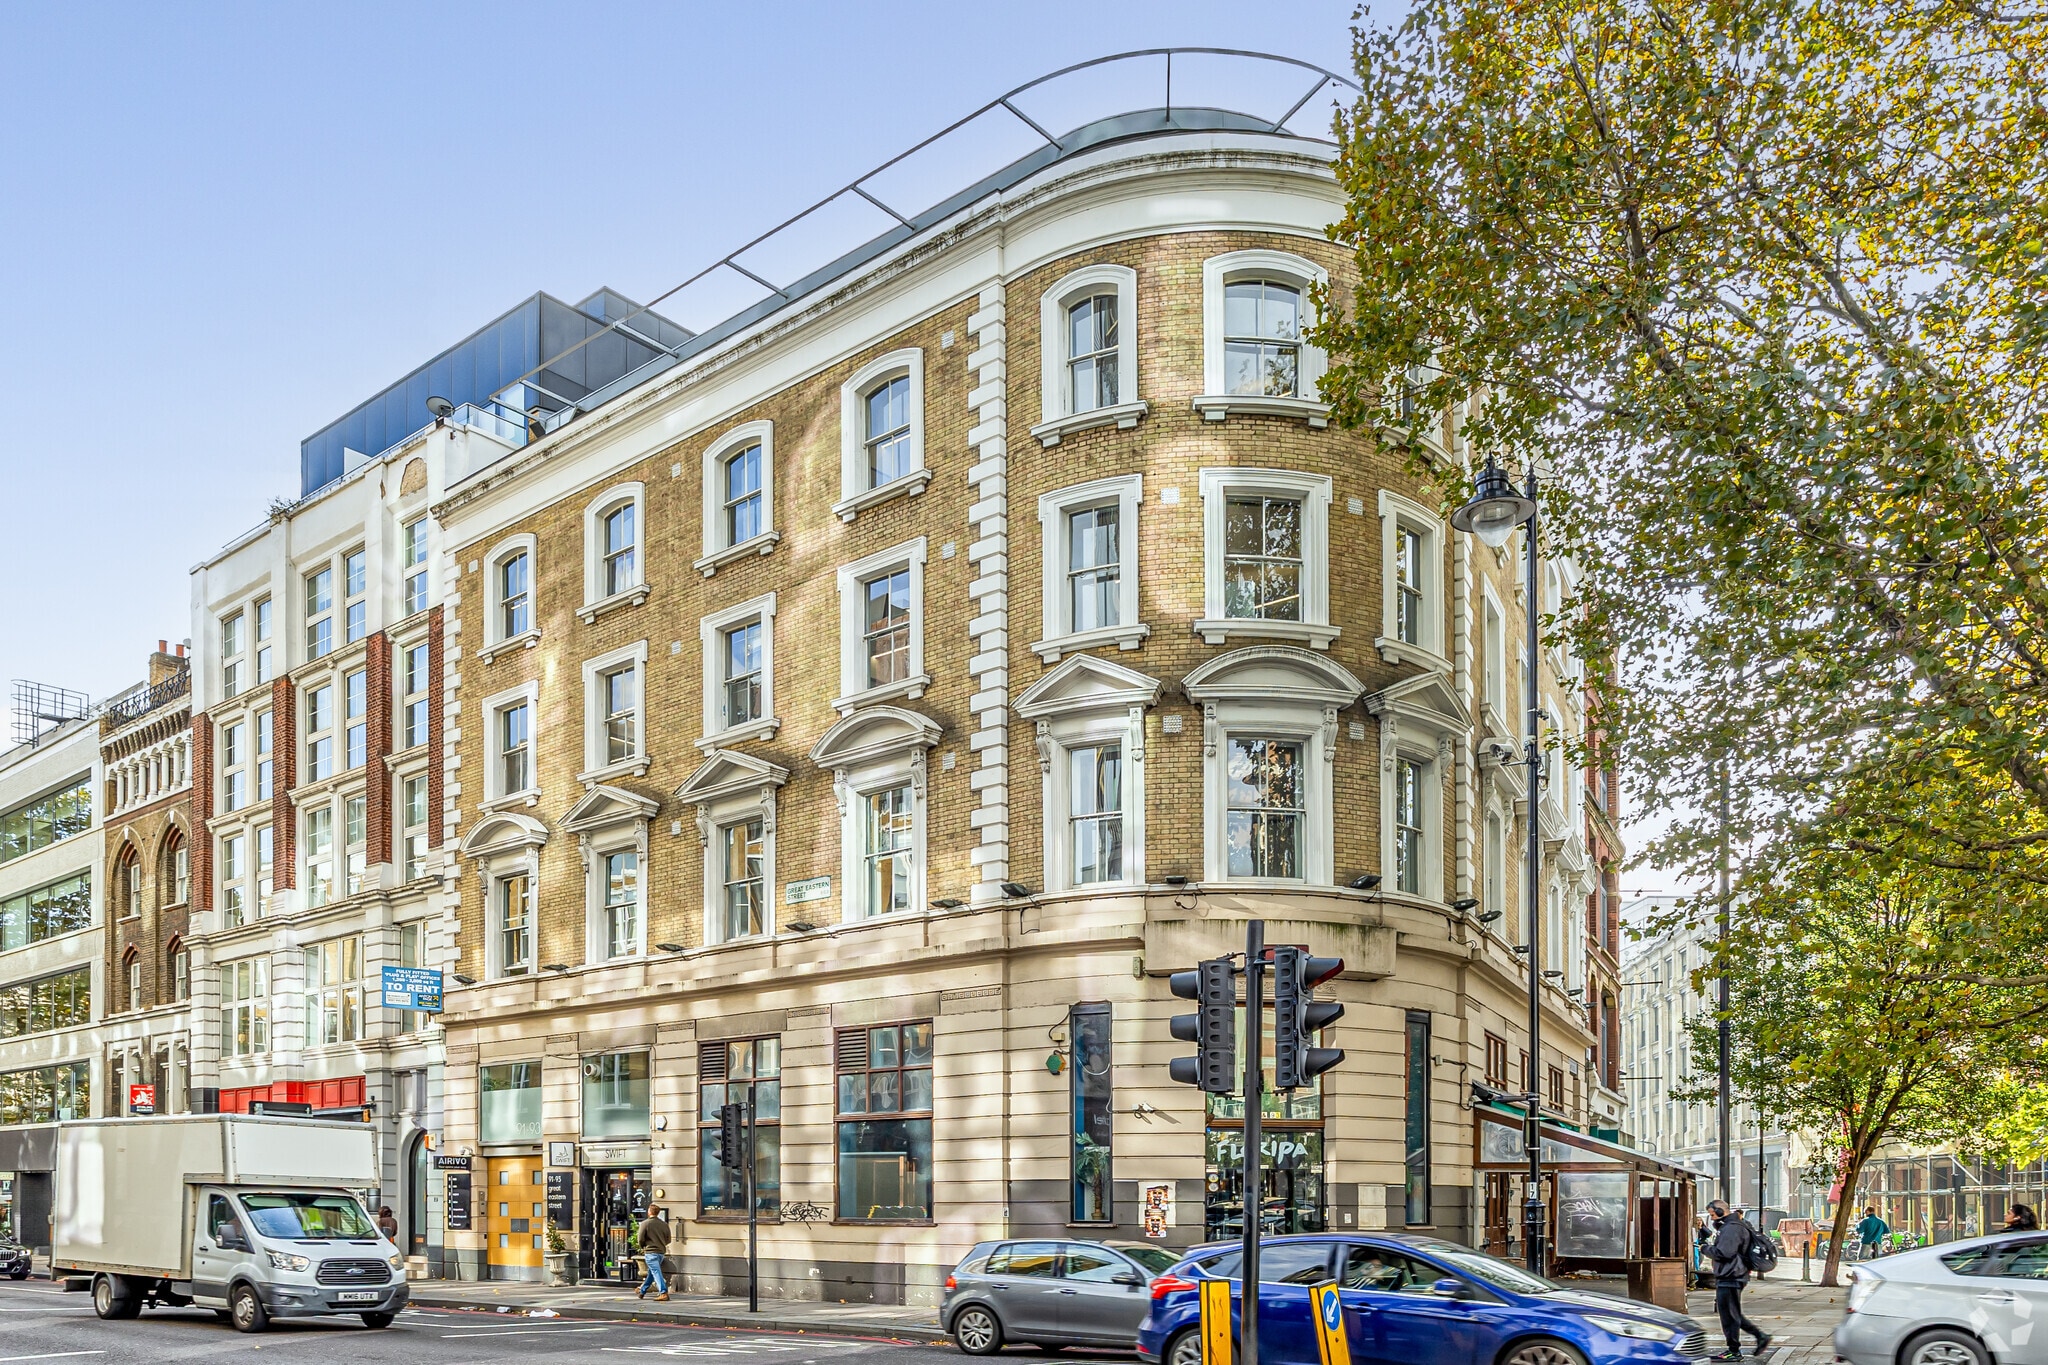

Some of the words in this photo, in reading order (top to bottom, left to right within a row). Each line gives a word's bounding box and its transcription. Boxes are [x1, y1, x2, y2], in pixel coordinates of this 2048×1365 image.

[787, 885, 804, 894] GREAT
[805, 881, 830, 891] EASTERN
[787, 892, 806, 901] STREET
[385, 982, 403, 991] TO
[406, 983, 440, 994] RENT
[605, 1148, 627, 1159] SWIFT
[438, 1157, 467, 1165] AIRIVO
[548, 1185, 561, 1194] great
